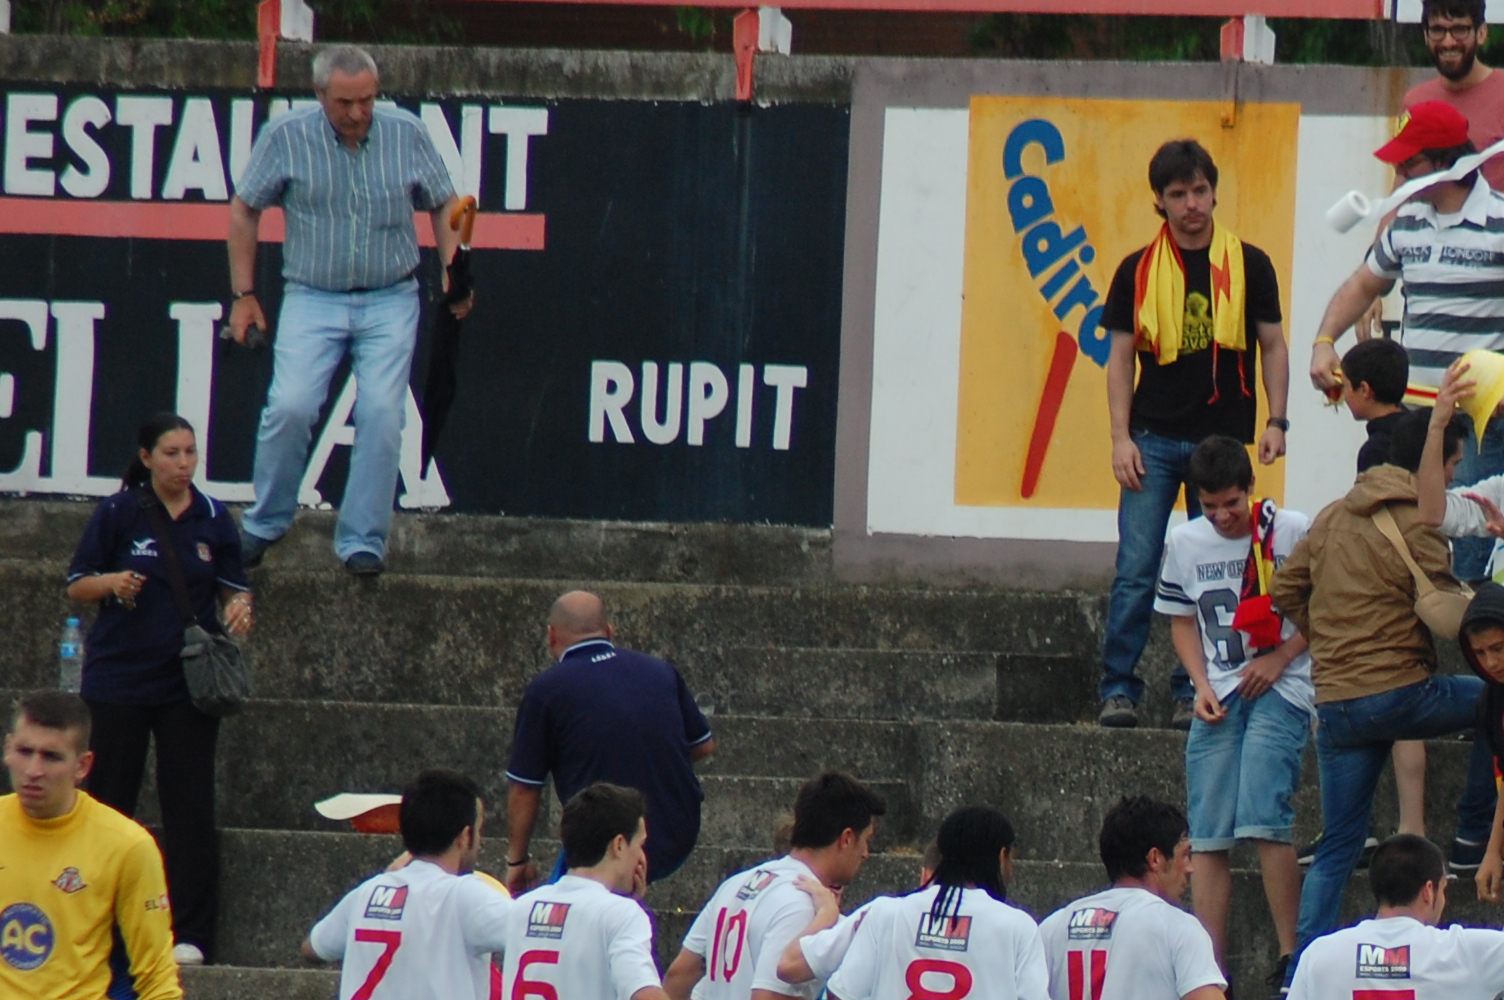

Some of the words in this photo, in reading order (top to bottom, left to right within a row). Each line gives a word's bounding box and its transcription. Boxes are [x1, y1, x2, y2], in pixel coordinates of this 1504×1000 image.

[588, 360, 808, 451] RUPIT
[1196, 559, 1227, 583] NEW
[2, 919, 47, 955] AC
[710, 907, 748, 983] 10
[1360, 944, 1409, 966] MM
